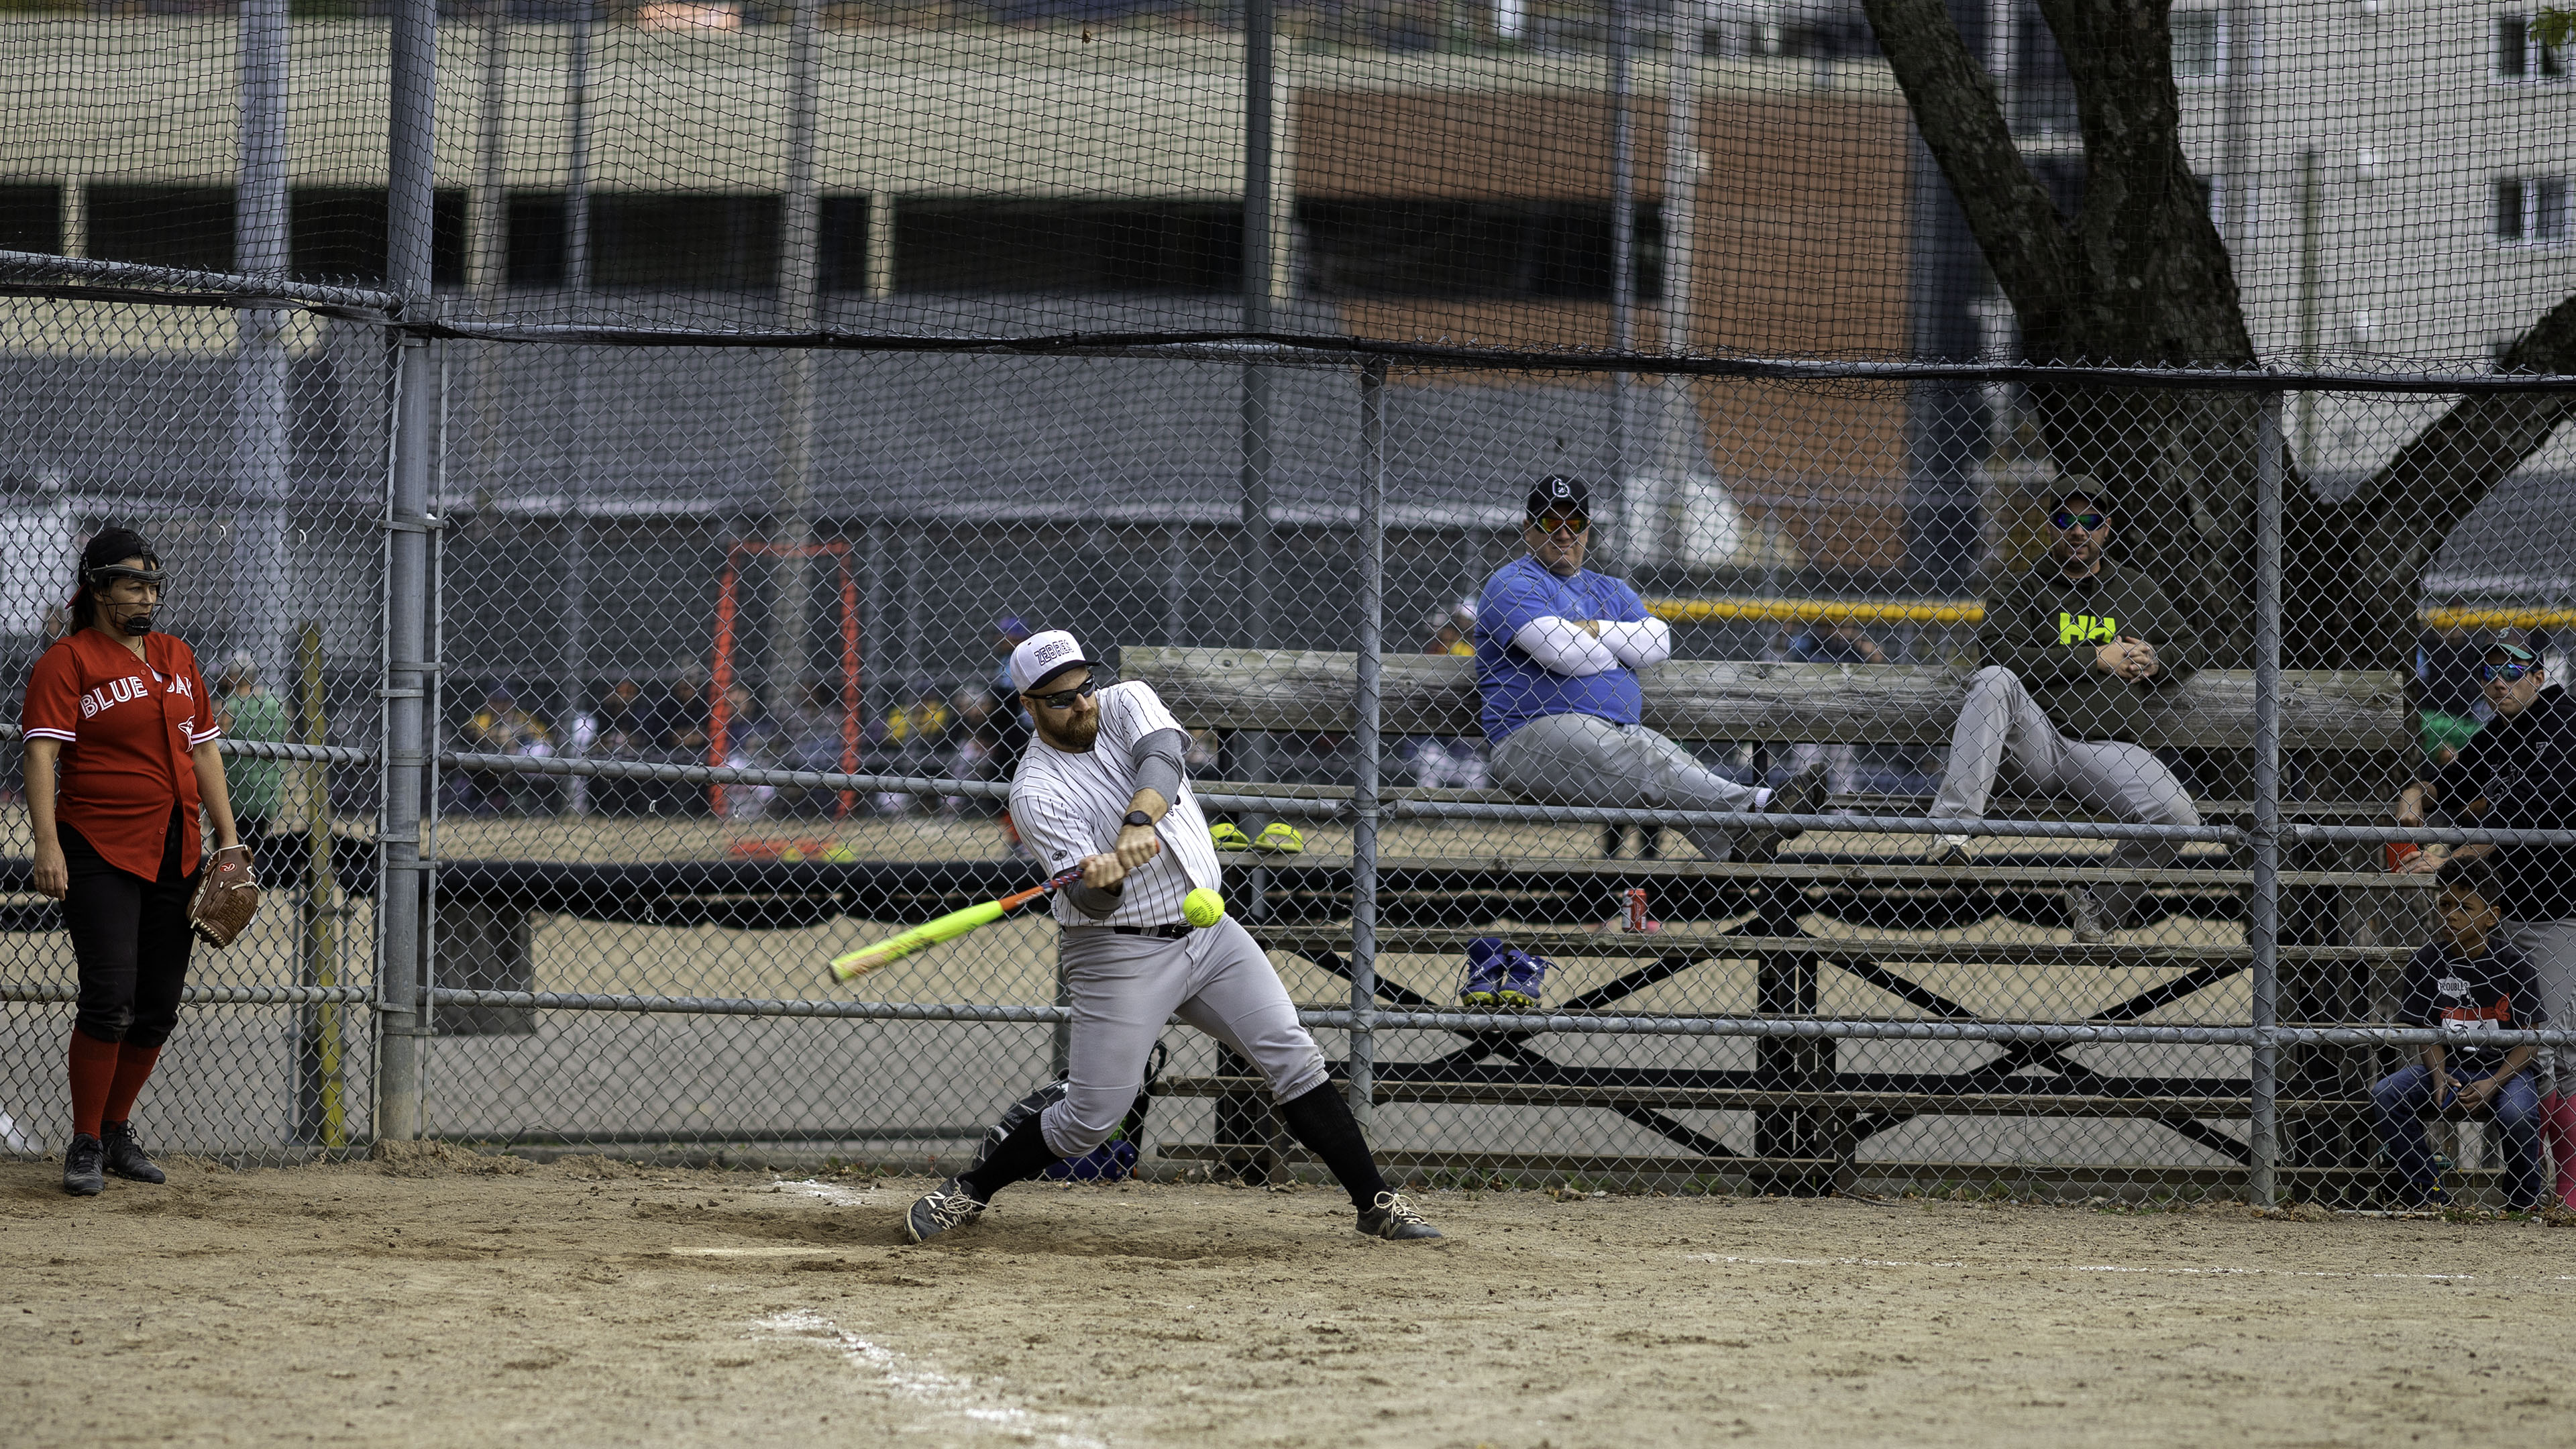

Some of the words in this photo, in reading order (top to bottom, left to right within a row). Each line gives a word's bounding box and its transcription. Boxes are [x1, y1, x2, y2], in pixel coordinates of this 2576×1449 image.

[2059, 612, 2116, 645] HH
[1034, 639, 1074, 666] ZEBRES
[80, 676, 148, 719] BLUE
[2536, 742, 2548, 757] 7
